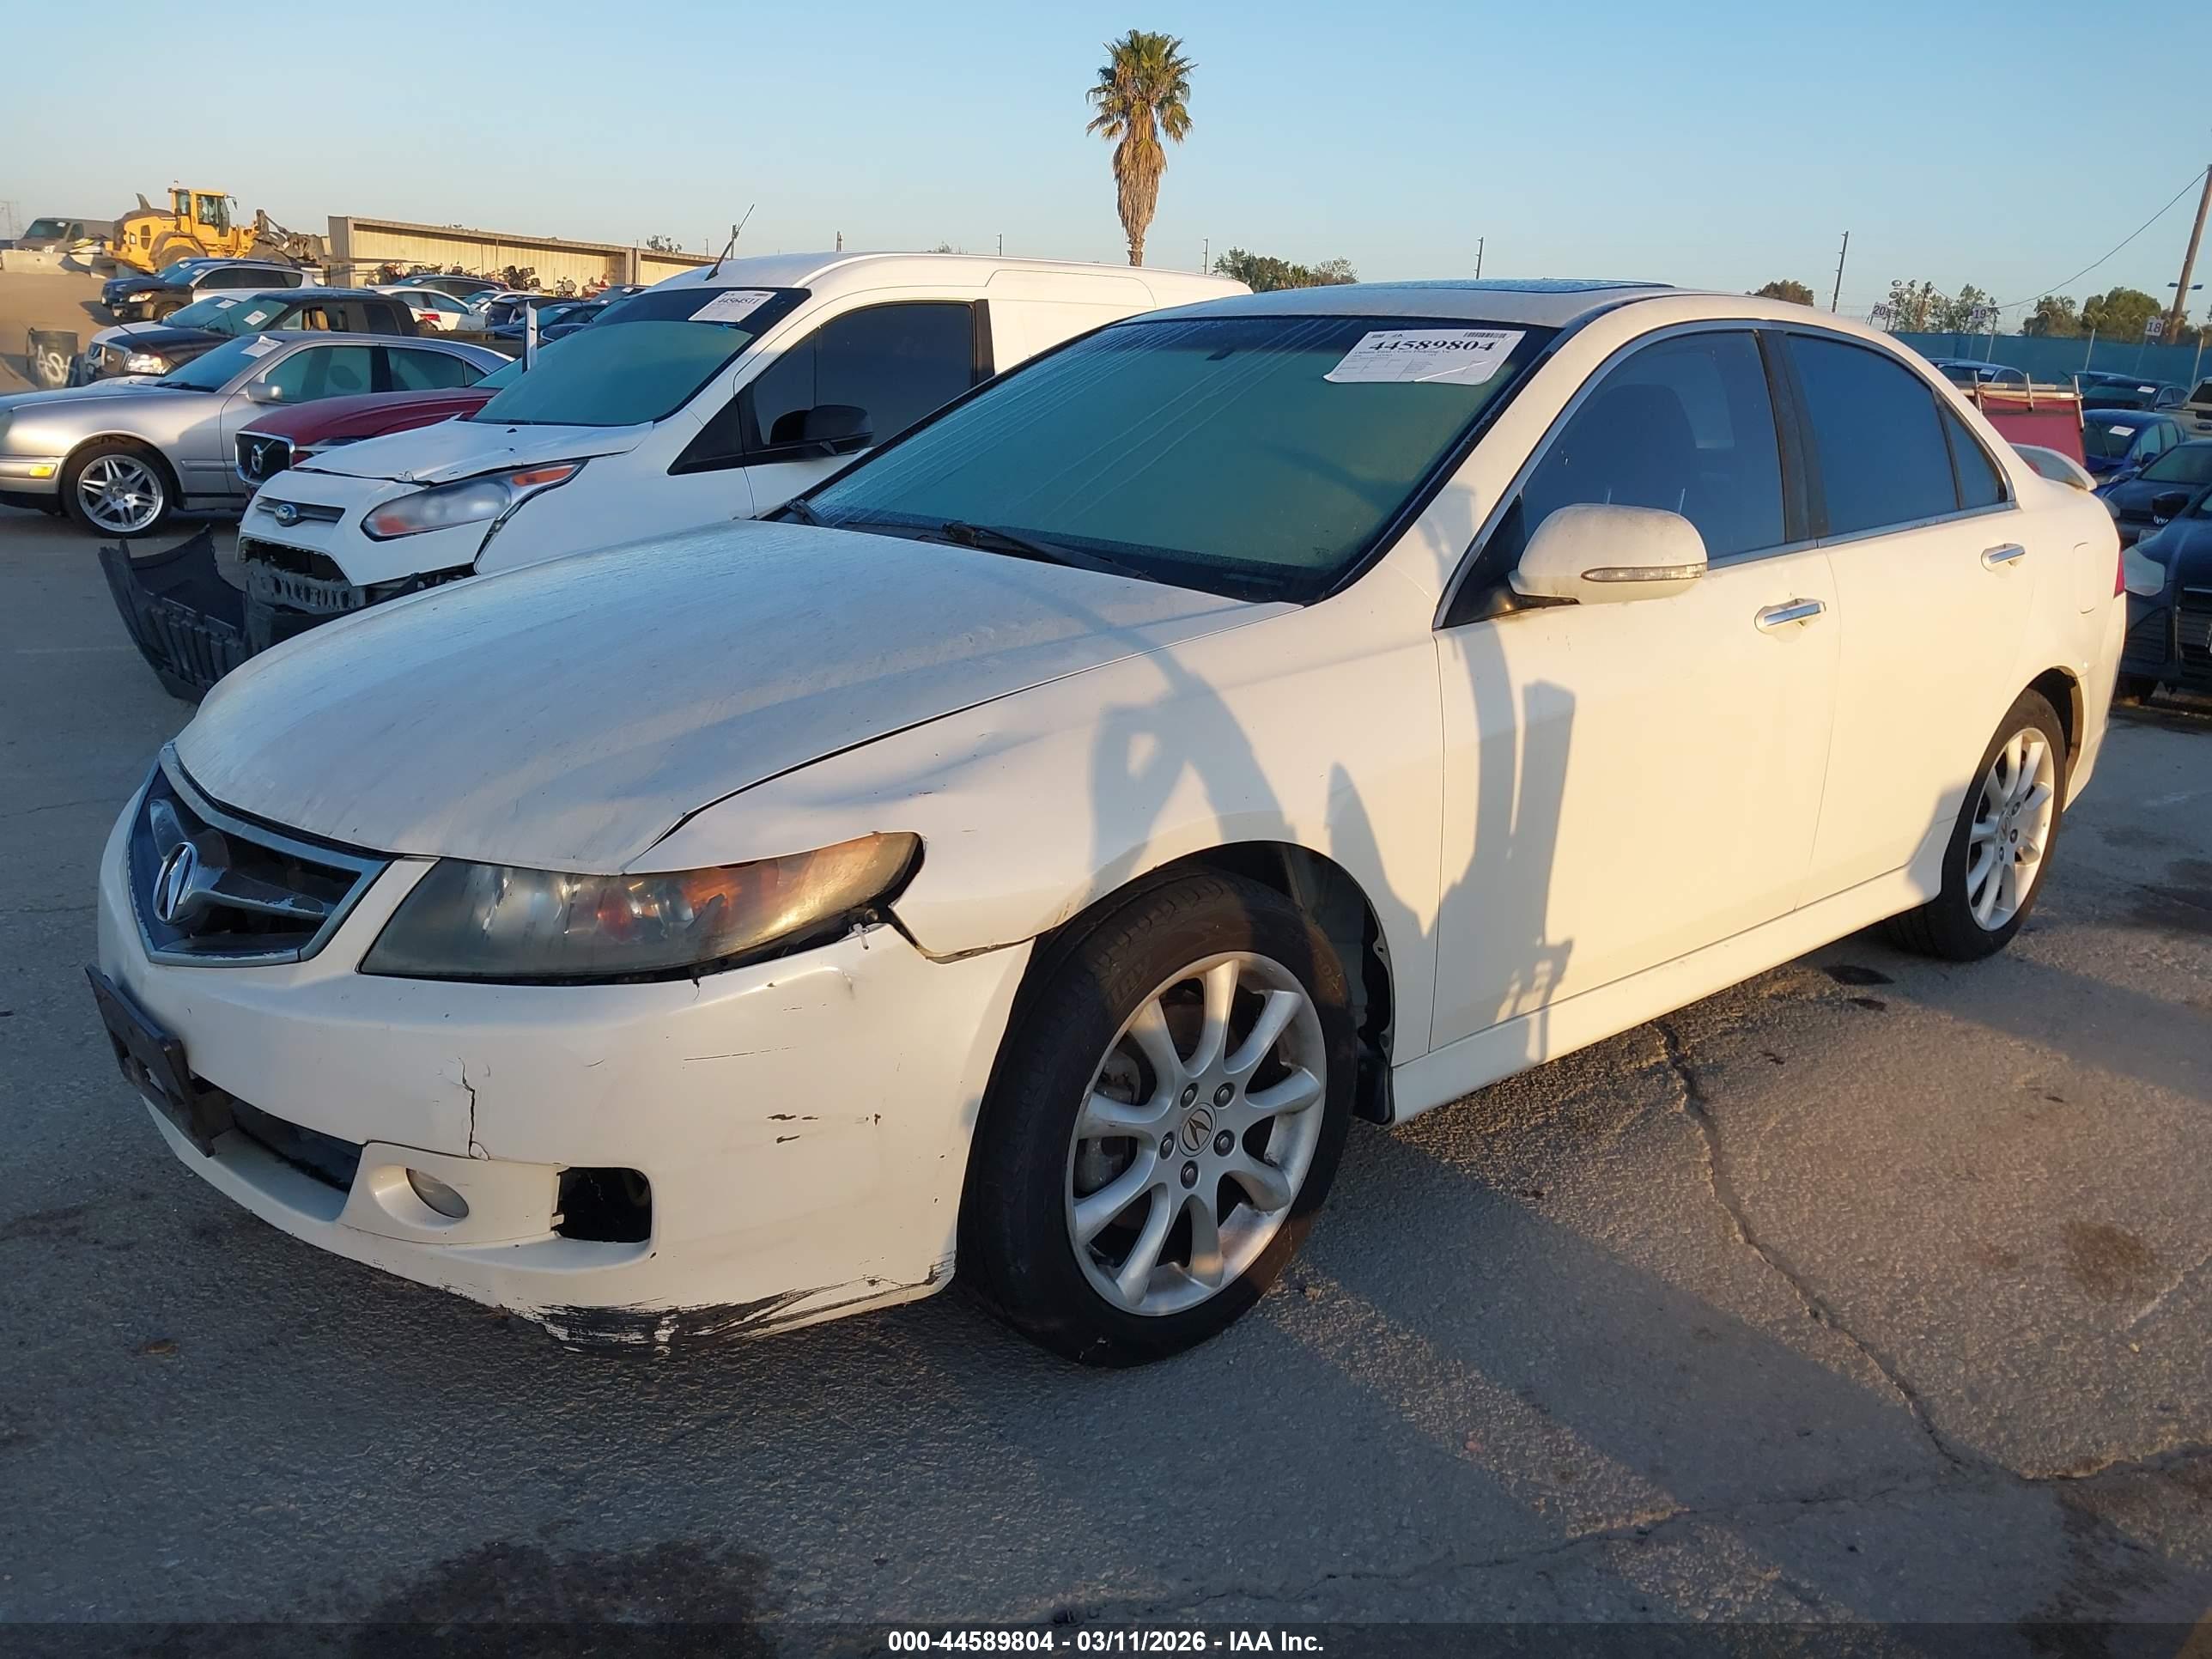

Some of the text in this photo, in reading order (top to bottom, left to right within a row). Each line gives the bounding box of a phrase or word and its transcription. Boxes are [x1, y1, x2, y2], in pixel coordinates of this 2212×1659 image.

[1873, 305, 1887, 316] 20
[1974, 308, 1987, 319] 19
[2147, 322, 2162, 332] 18
[1369, 340, 1496, 351] 44589804
